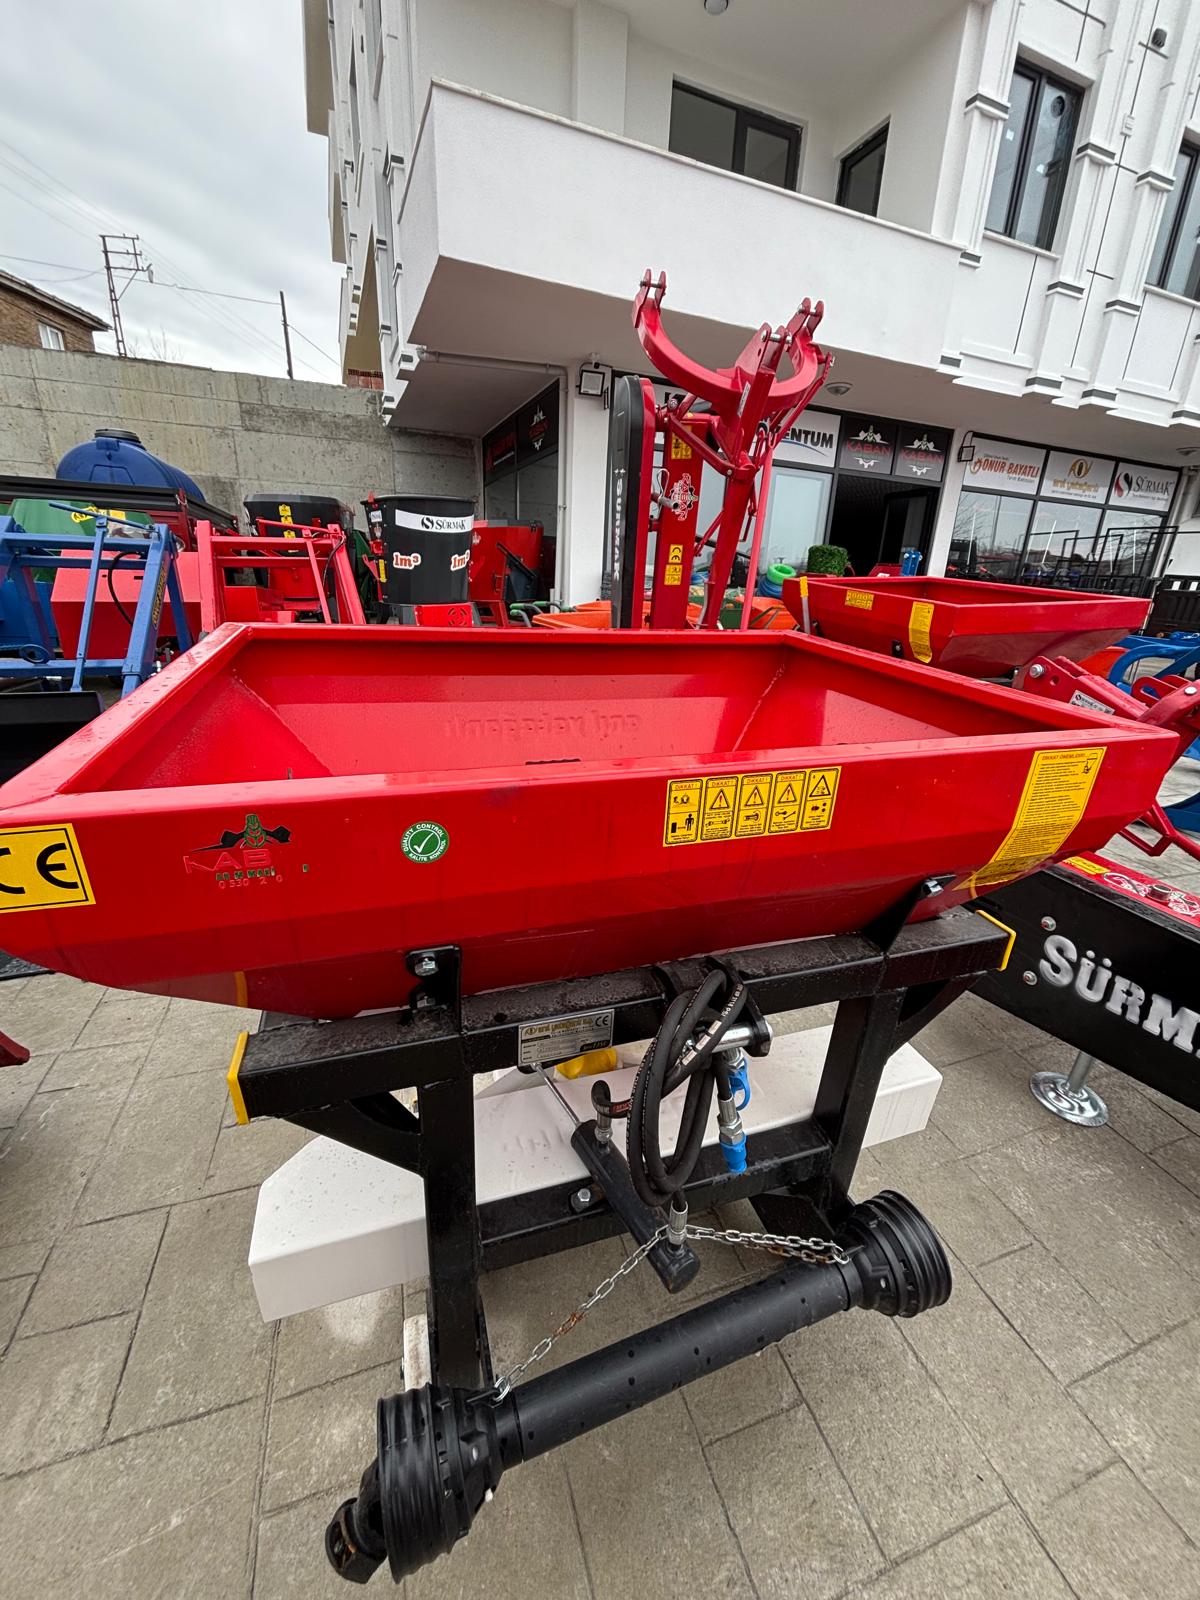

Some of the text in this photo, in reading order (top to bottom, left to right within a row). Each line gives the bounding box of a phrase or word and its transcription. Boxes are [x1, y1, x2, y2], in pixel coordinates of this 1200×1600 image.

[846, 440, 891, 456] KABAN
[901, 448, 944, 463] KABAN
[981, 458, 1040, 478] ONUR BAYATLI
[435, 519, 466, 530] SÜRMAK
[416, 823, 445, 837] CONTROL
[403, 828, 414, 852] QUALITY
[1039, 934, 1200, 1059] SÜRM
[595, 1015, 609, 1027] CE
